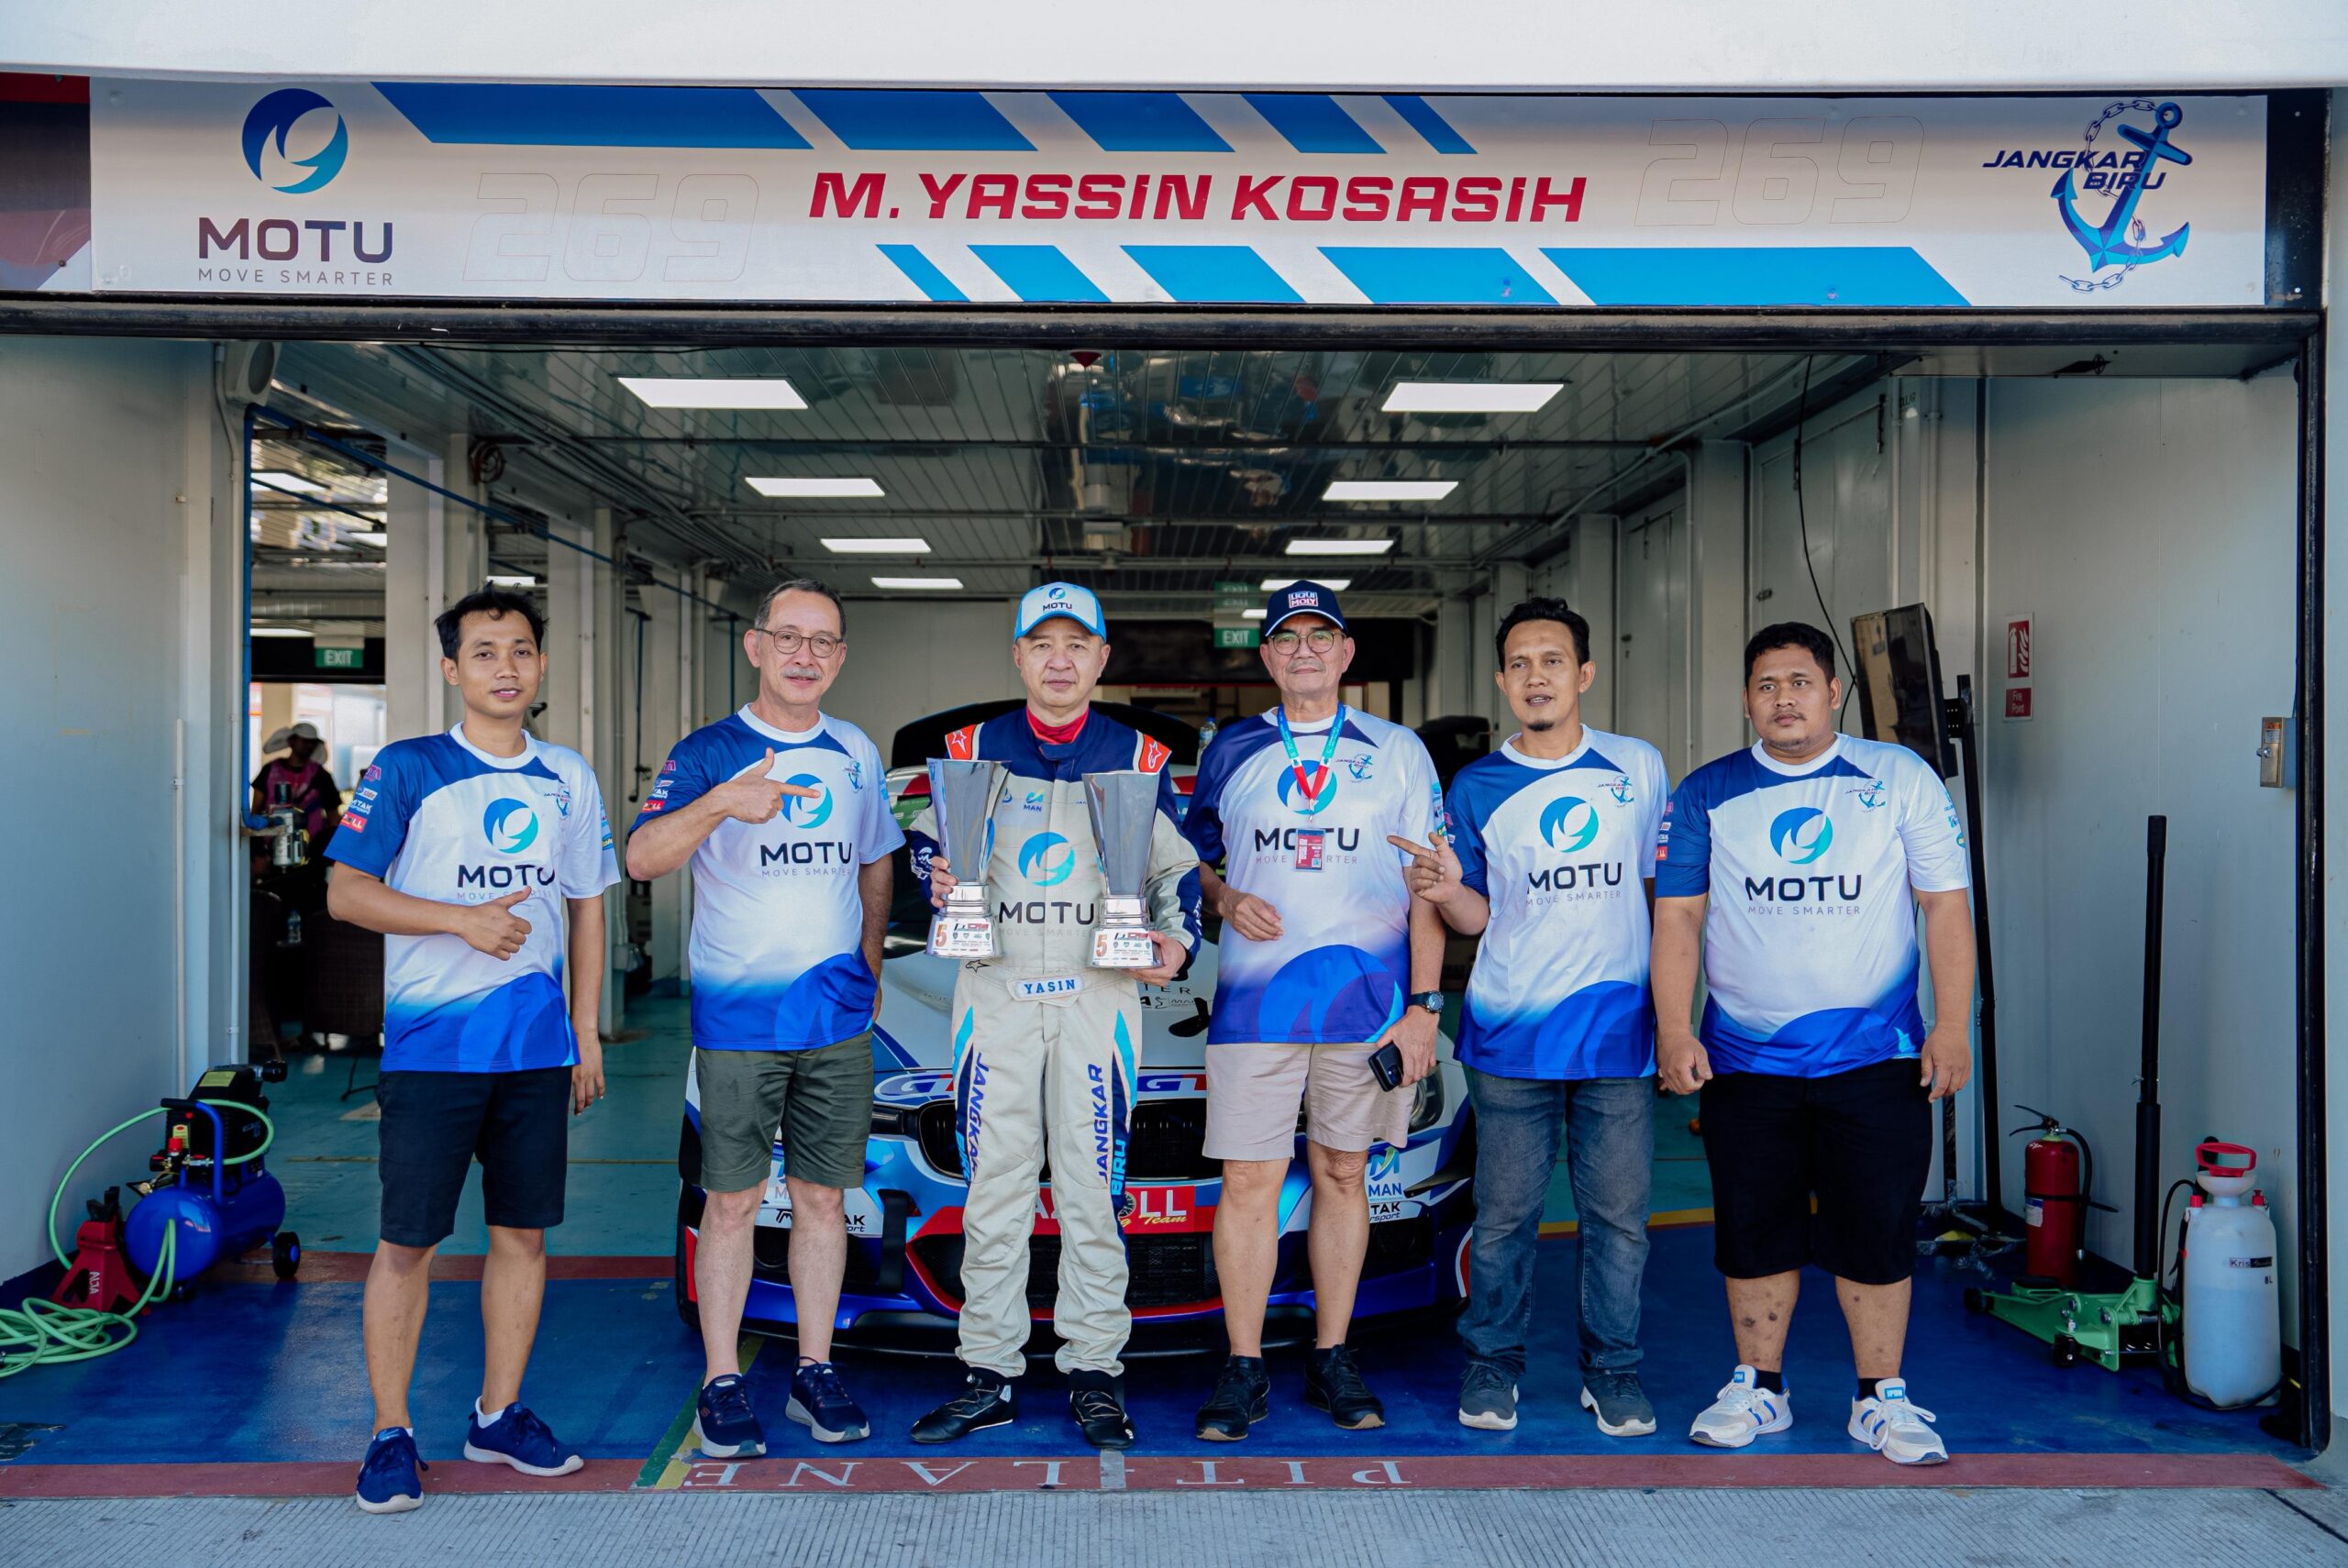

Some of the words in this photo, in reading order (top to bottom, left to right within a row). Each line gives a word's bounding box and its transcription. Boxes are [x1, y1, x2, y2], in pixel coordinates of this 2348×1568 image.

[1634, 116, 1924, 226] 269
[1982, 149, 2147, 170] JANGKAR
[2082, 171, 2167, 190] BIRU
[808, 171, 900, 219] M.
[916, 172, 1213, 221] YASSIN
[1230, 175, 1588, 223] KOSASIH
[462, 171, 759, 282] 269
[198, 216, 393, 264] MOTU
[198, 268, 264, 282] MOVE
[280, 270, 393, 286] SMARTER
[1043, 602, 1073, 612] MOTU
[1222, 630, 1250, 646] EXIT
[324, 649, 353, 667] EXIT
[1023, 803, 1043, 812] MAN
[759, 841, 852, 867] MOTU
[1256, 855, 1288, 865] MOVE
[457, 864, 556, 889] MOTU
[761, 867, 798, 878] MOVE
[1526, 862, 1623, 895] MOTU
[1525, 895, 1560, 907] MOVE
[1567, 890, 1621, 902] SMARTER
[1744, 874, 1862, 901] MOTU
[998, 901, 1095, 925] MOTU
[1747, 905, 1784, 915] MOVE
[1792, 905, 1861, 915] SMARTER
[935, 923, 947, 947] 5
[1095, 933, 1108, 957] 5
[1024, 978, 1077, 995] YASIN
[1088, 1063, 1109, 1185] JANGKAR
[1111, 1139, 1126, 1196] BIRU
[1368, 1182, 1402, 1198] MAN
[1143, 1215, 1188, 1226] Team
[683, 1461, 1070, 1486] LANE
[1176, 1461, 1412, 1485] PIT
